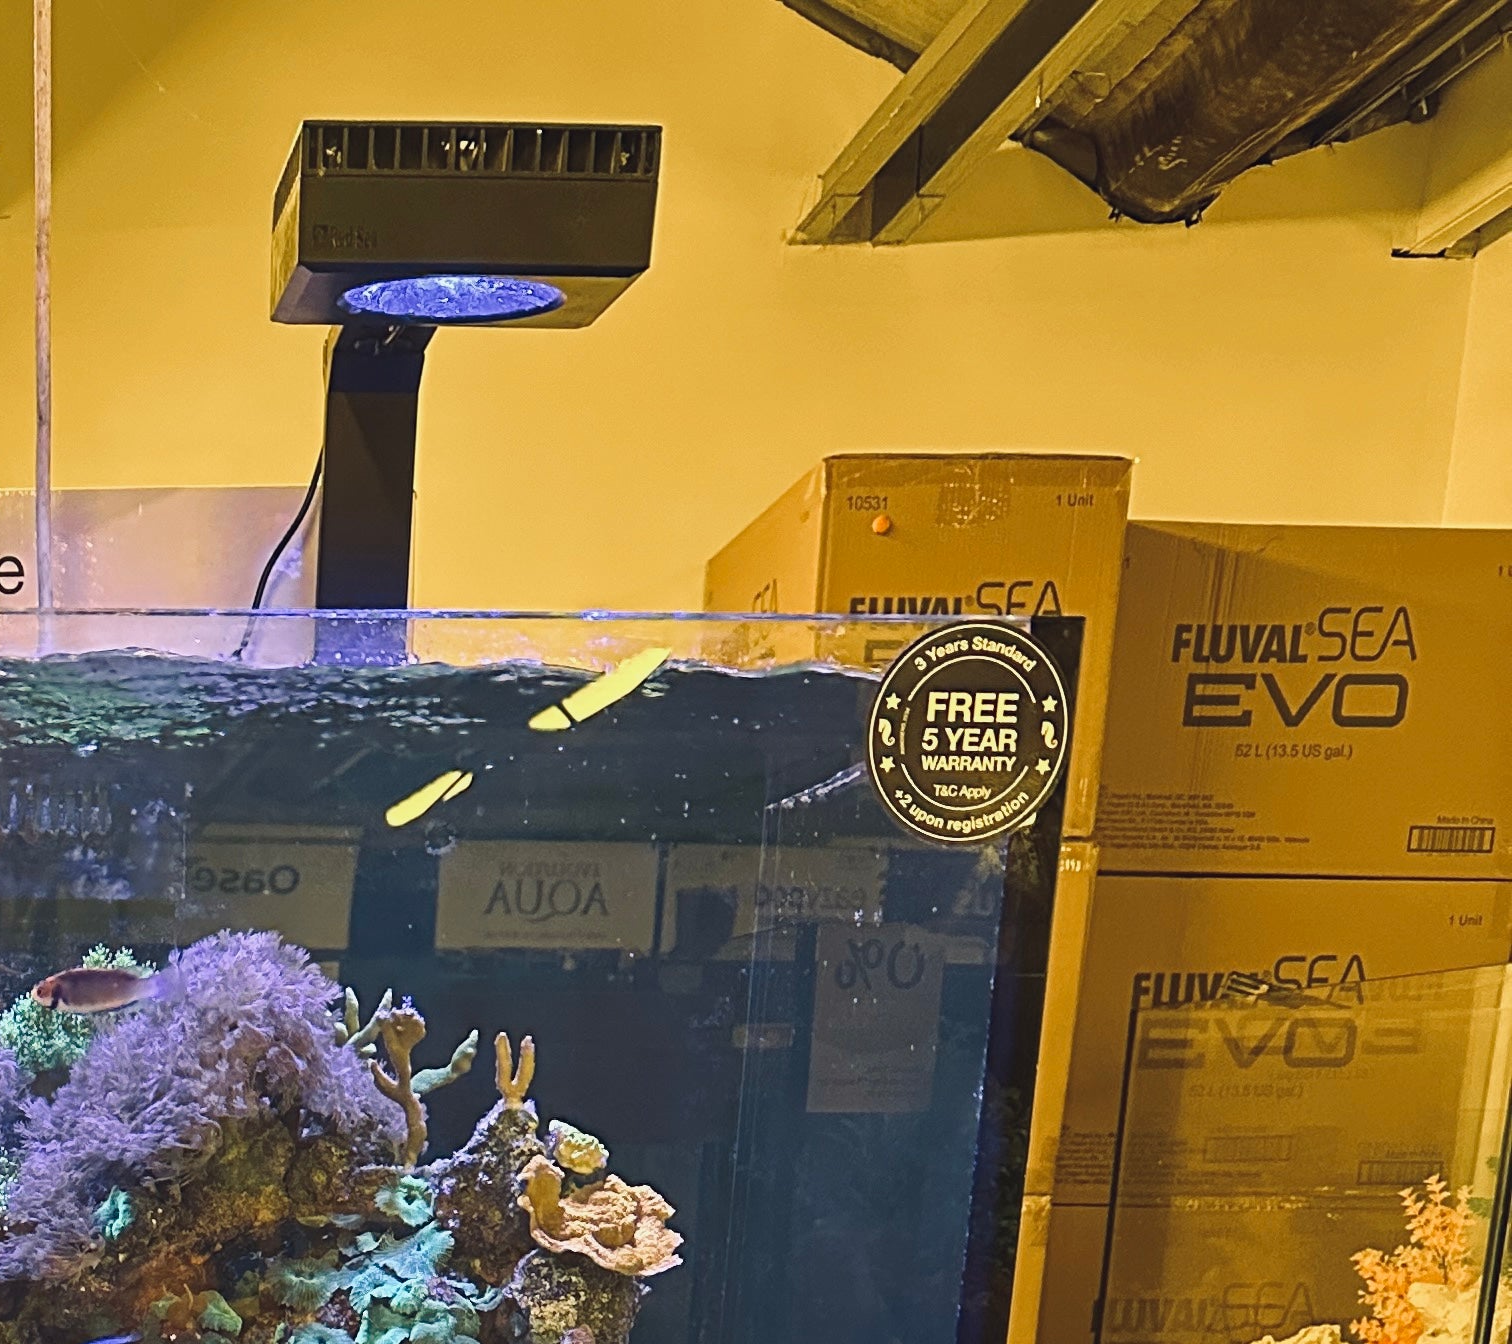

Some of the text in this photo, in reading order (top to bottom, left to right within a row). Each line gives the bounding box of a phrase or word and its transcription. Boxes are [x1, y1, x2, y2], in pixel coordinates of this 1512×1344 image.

[847, 496, 889, 510] 10531
[1056, 495, 1094, 507] 1 Unit
[1172, 606, 1417, 663] FLUVAL SEA
[915, 657, 927, 671] 3
[926, 640, 969, 662] Years
[972, 636, 1037, 673] Standard
[926, 692, 1020, 723] FREE
[1182, 672, 1409, 728] EVO
[922, 728, 938, 750] 5
[944, 728, 1018, 752] YEAR
[1234, 743, 1252, 758] 52
[1302, 743, 1322, 758] US
[921, 755, 1016, 772] WARRANTY
[934, 784, 991, 799] T&C Apply
[909, 804, 944, 829] upon
[946, 792, 1030, 834] registration
